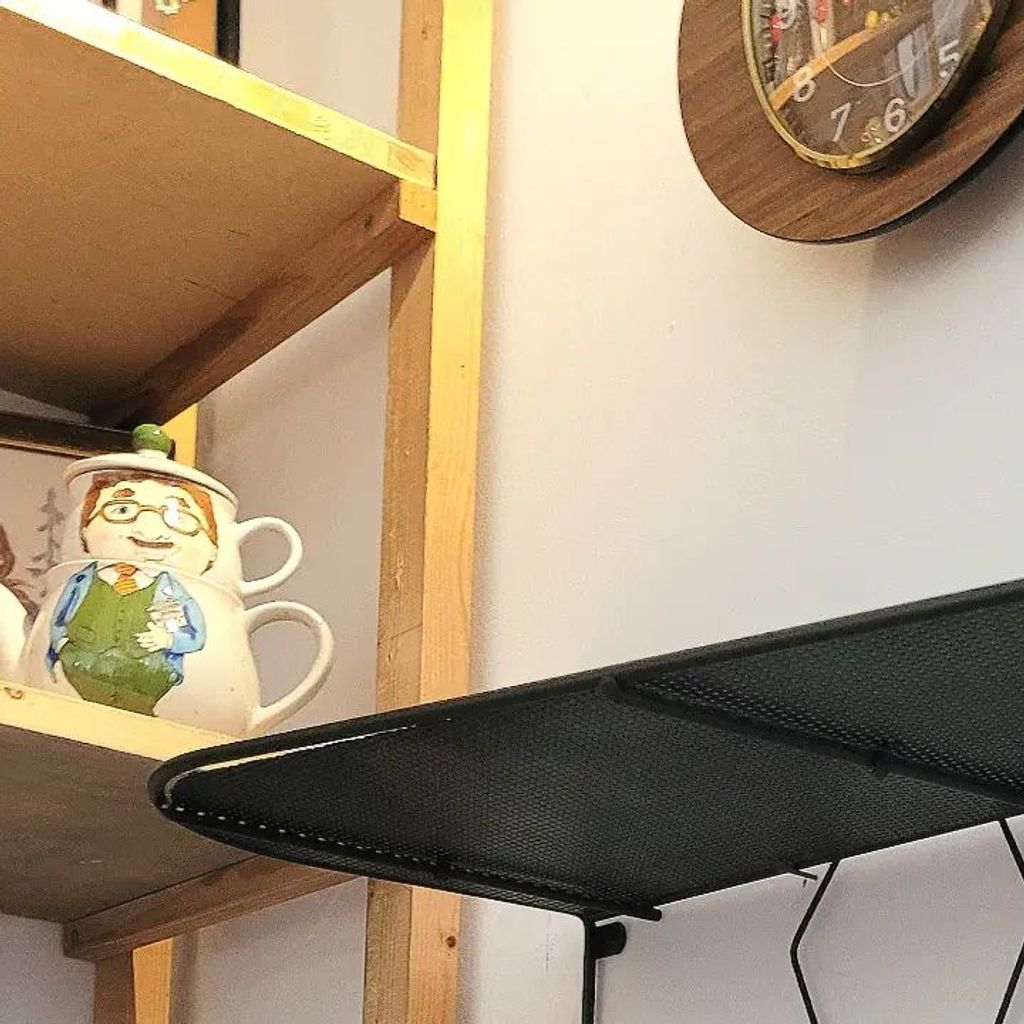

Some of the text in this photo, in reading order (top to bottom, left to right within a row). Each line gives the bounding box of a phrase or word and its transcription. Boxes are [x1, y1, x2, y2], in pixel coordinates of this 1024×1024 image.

[938, 39, 961, 78] 5
[830, 101, 853, 143] 7
[883, 97, 907, 133] 6
